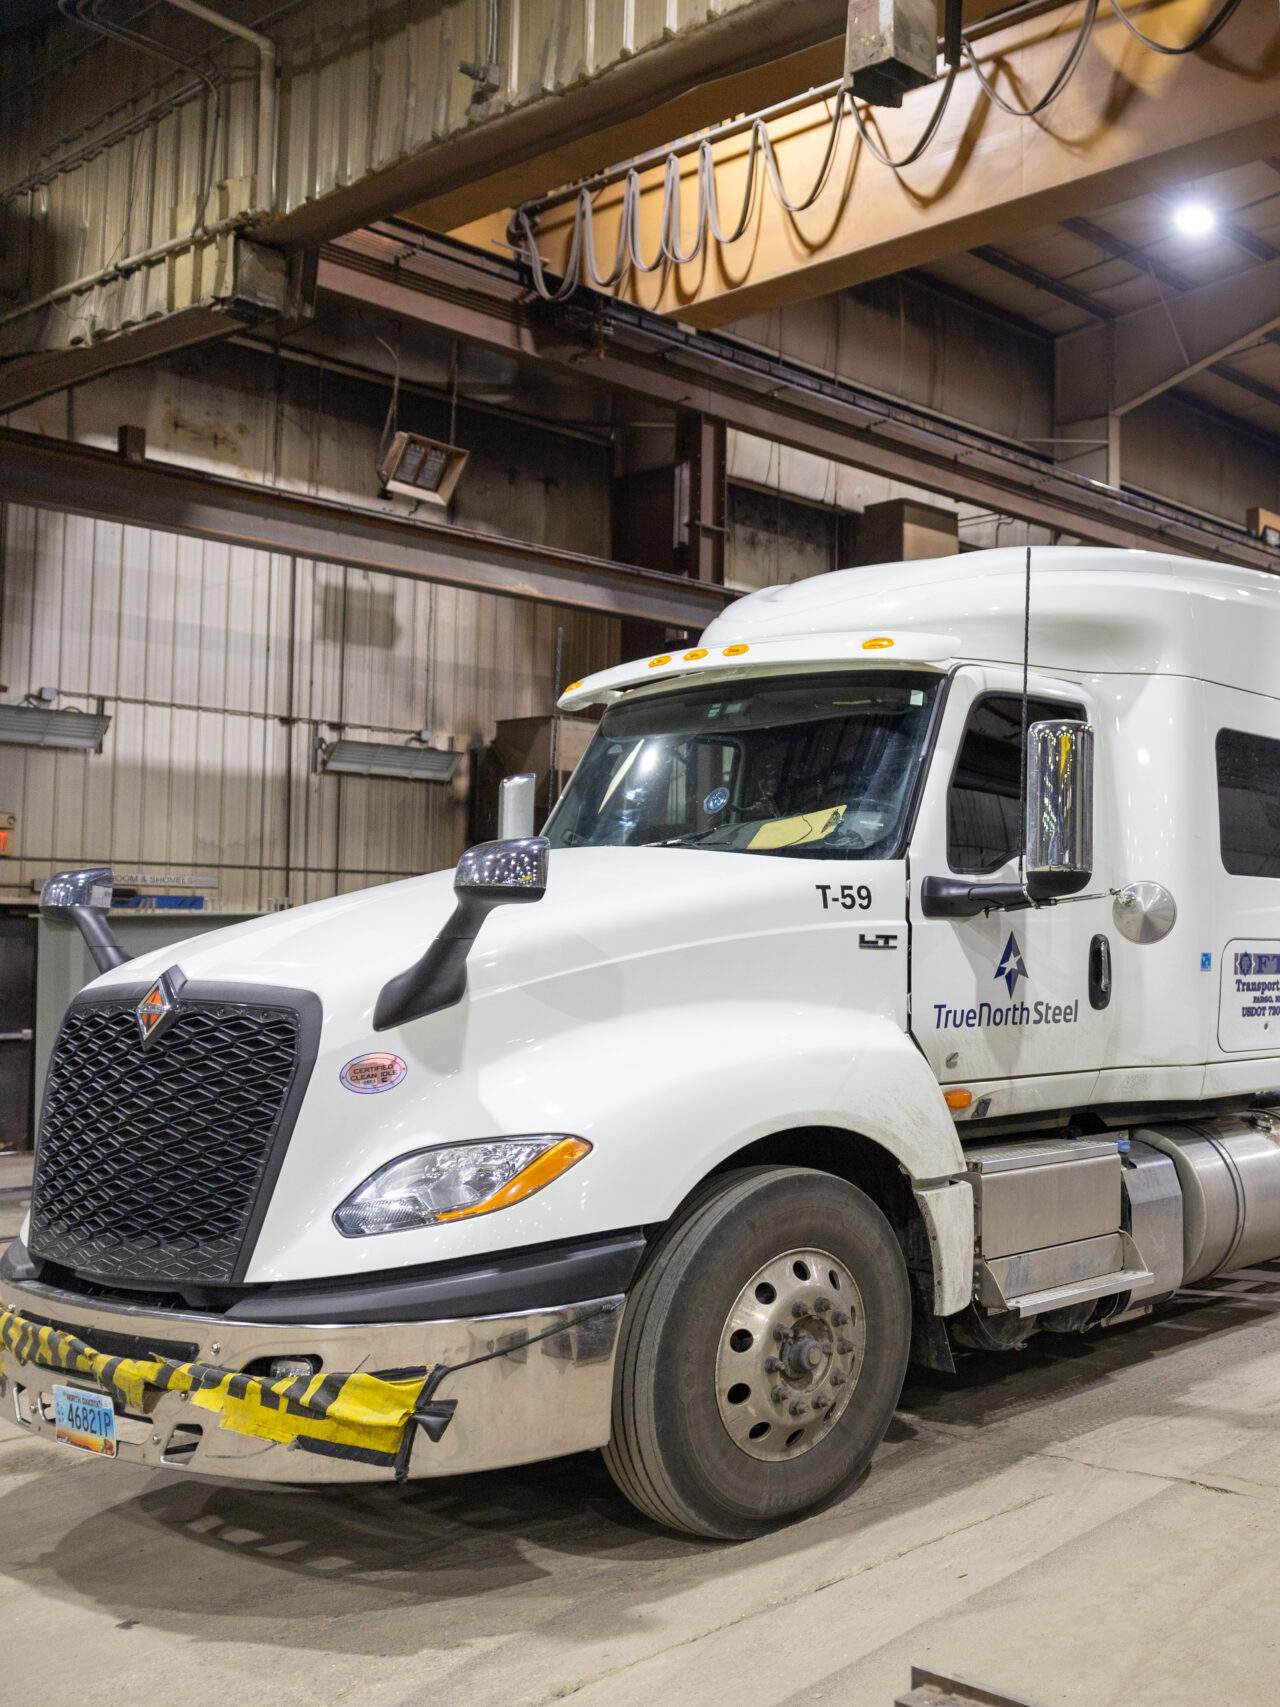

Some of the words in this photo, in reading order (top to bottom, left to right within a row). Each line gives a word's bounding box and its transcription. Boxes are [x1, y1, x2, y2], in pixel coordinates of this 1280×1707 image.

[815, 884, 872, 910] T-59
[1032, 999, 1079, 1024] Steel
[1241, 1006, 1267, 1017] USDOT
[350, 1073, 377, 1081] CLEAN
[353, 1064, 393, 1074] CERTIFIED
[67, 1403, 111, 1437] 46821P
